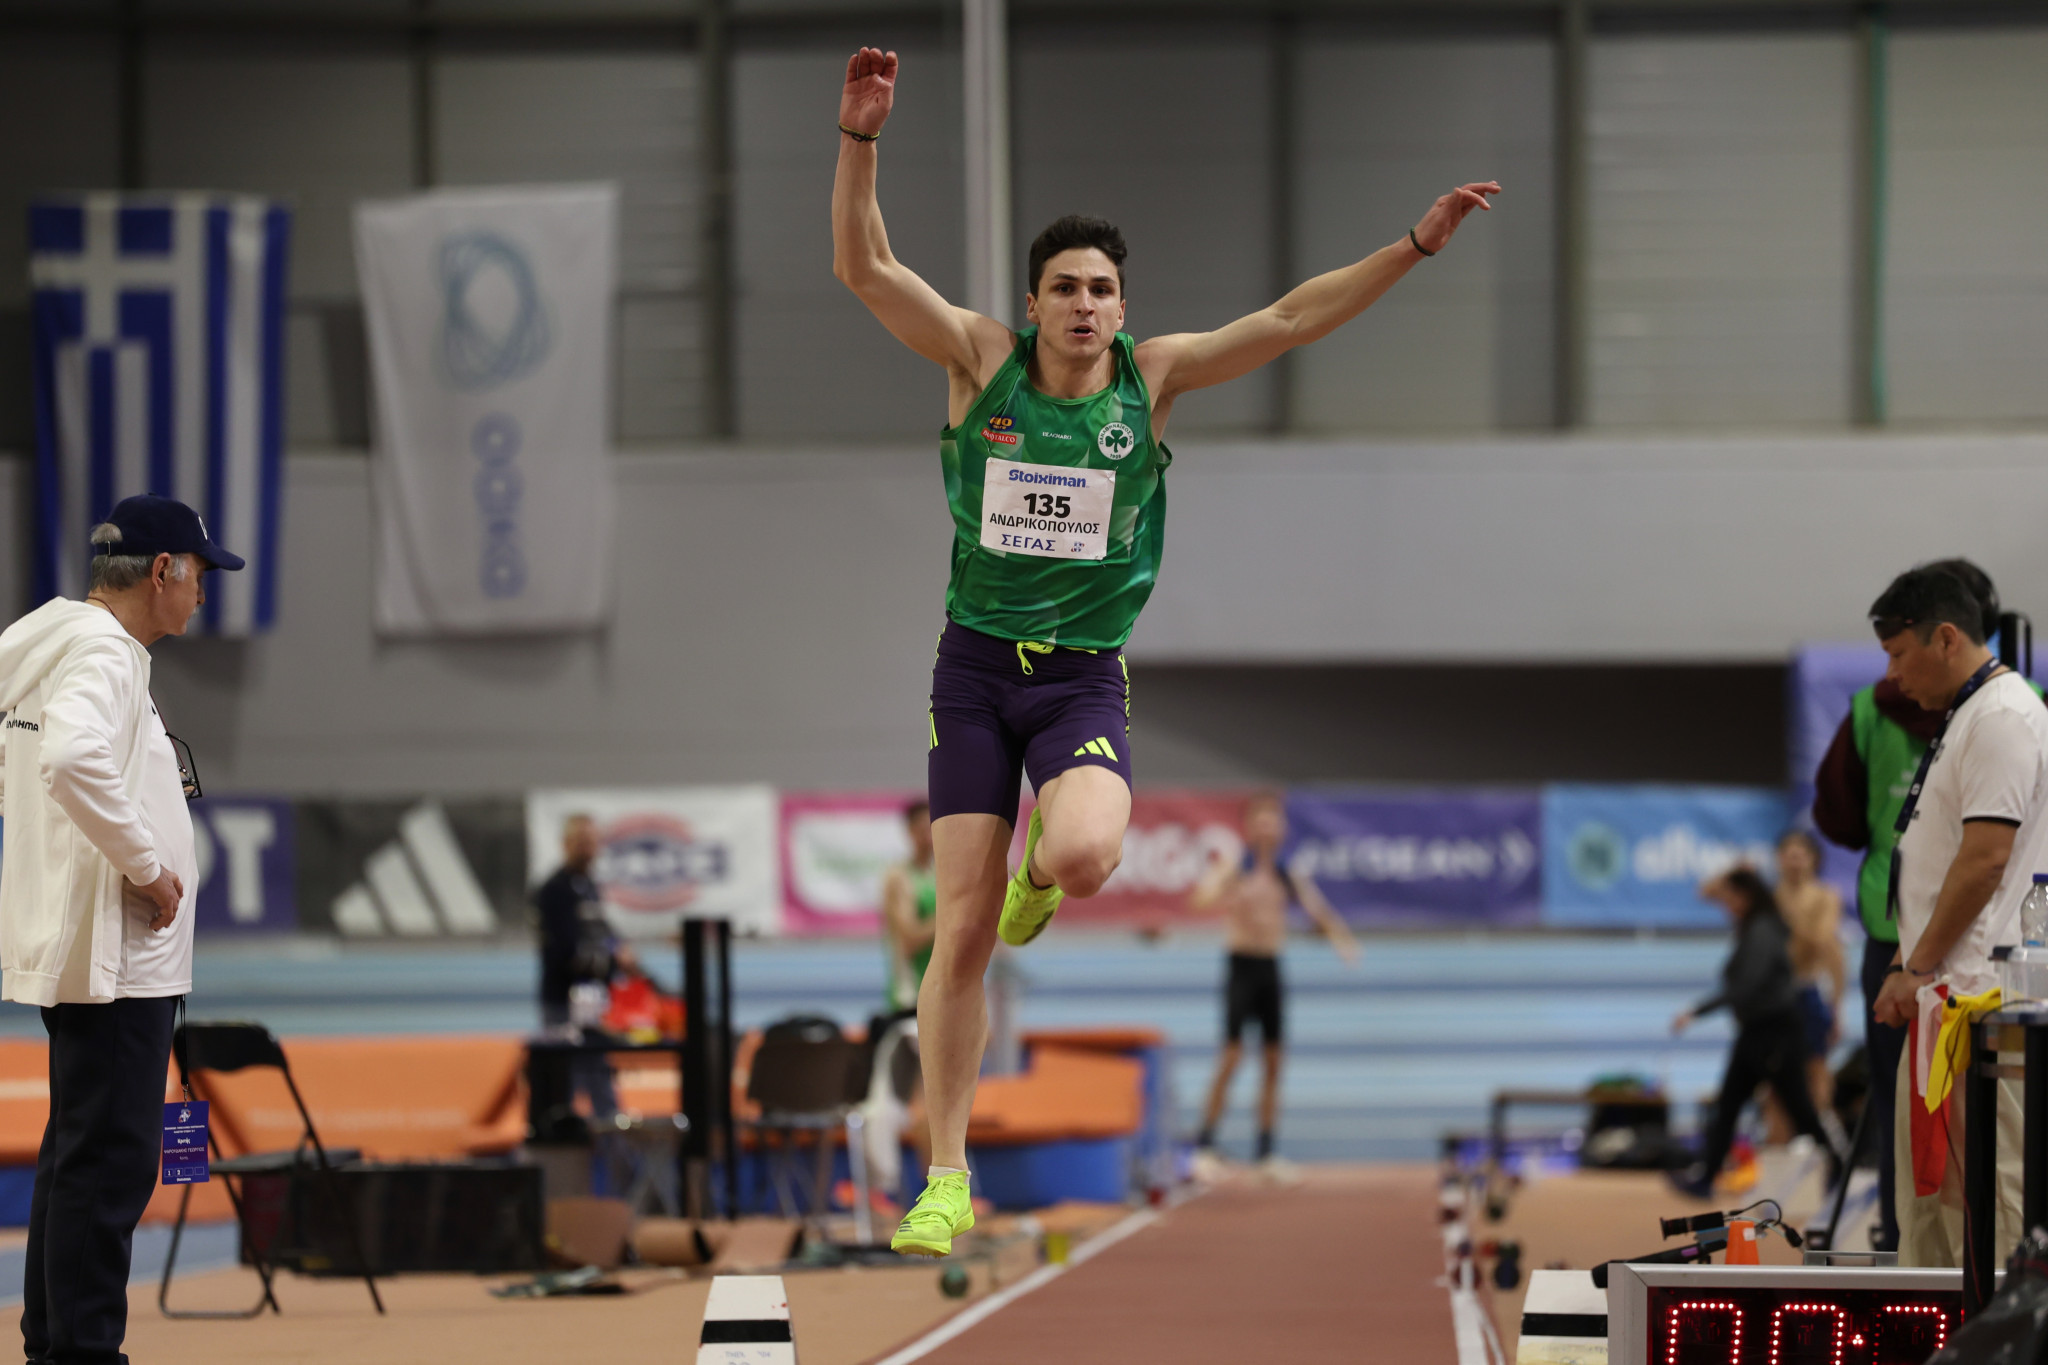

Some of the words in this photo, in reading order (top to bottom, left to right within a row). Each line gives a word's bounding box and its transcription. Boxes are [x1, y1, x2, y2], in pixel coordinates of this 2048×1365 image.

[1008, 469, 1086, 488] Stoiximan
[1023, 493, 1071, 519] 135
[989, 512, 1100, 534] ΑΝΔΡΙΚΟΠΟΥΛΟΣ
[1001, 533, 1056, 552] ΣΕΓΑΣ
